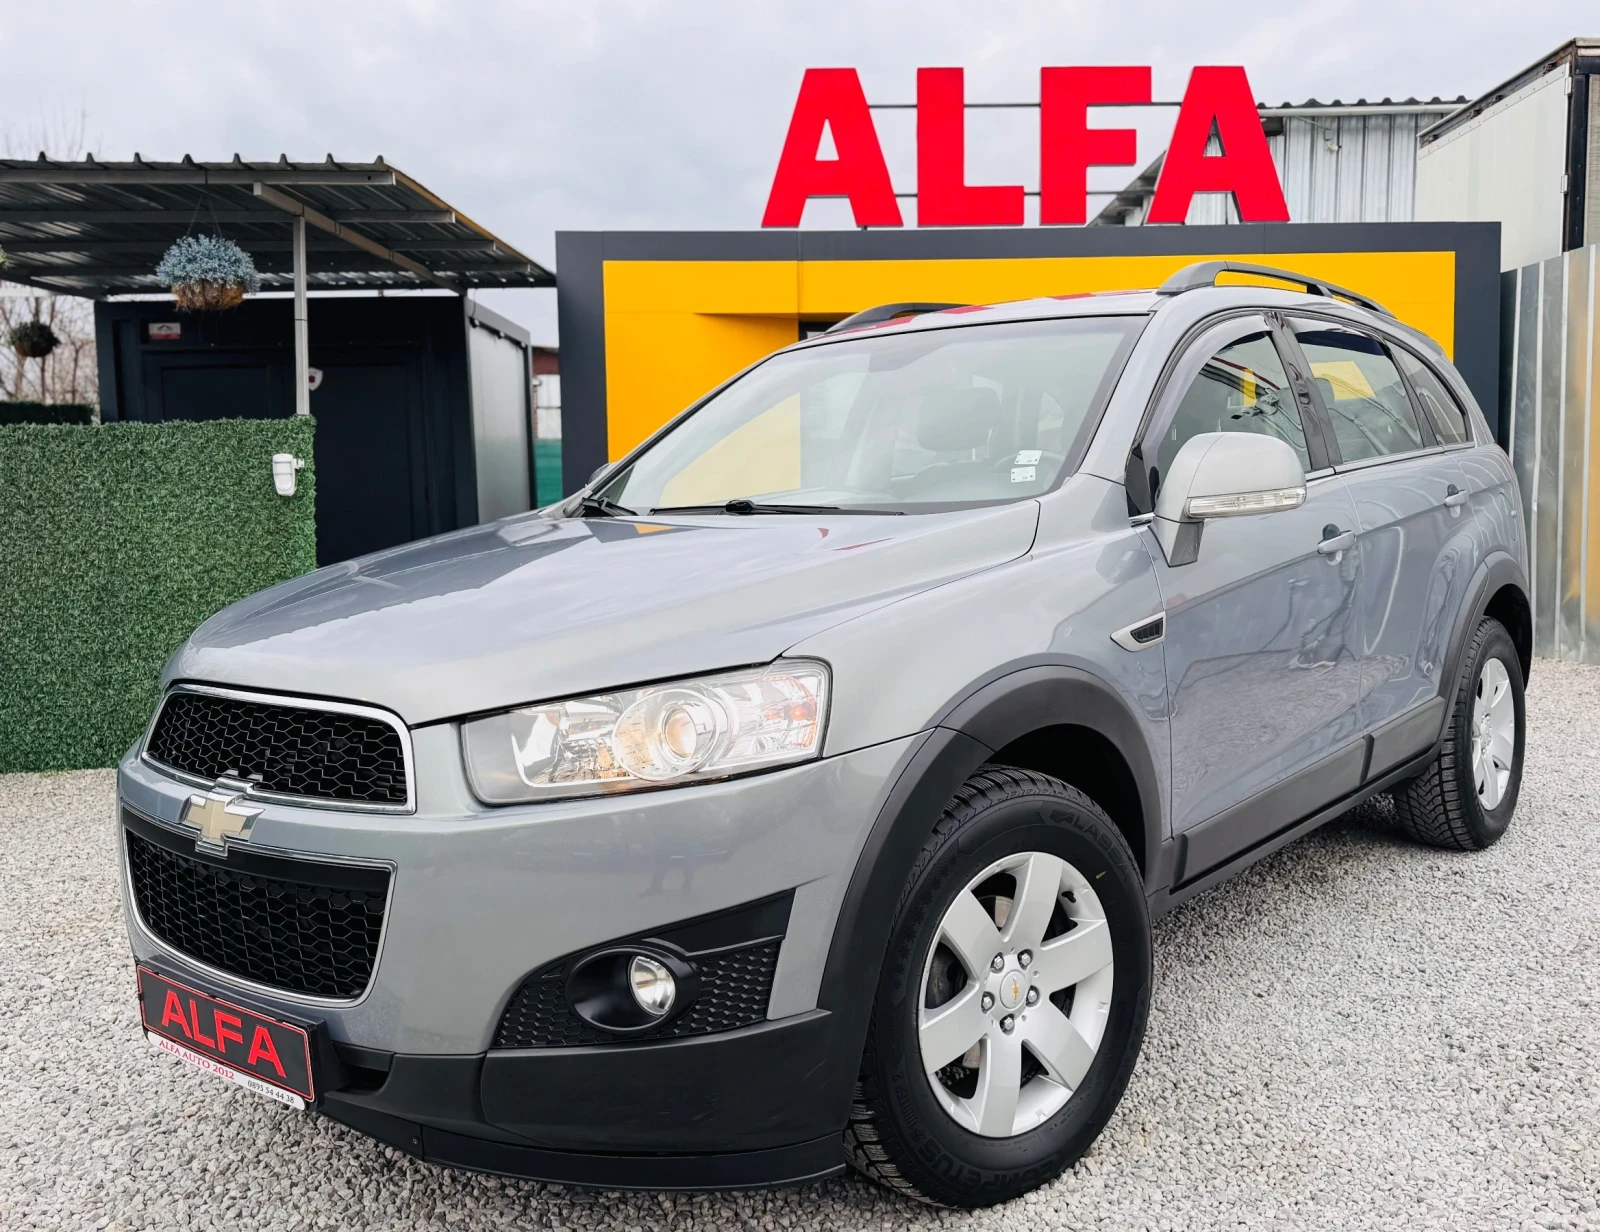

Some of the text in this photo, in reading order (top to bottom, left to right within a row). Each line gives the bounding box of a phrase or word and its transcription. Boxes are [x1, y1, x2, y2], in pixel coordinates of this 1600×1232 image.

[761, 65, 1291, 228] ALFA
[1072, 811, 1129, 884] LASSA
[159, 1039, 235, 1080] ALFA AUTO 2012
[161, 988, 287, 1079] ALFA
[247, 1080, 295, 1104] 0895 54 44 38
[917, 1137, 1054, 1191] COMPETUS
